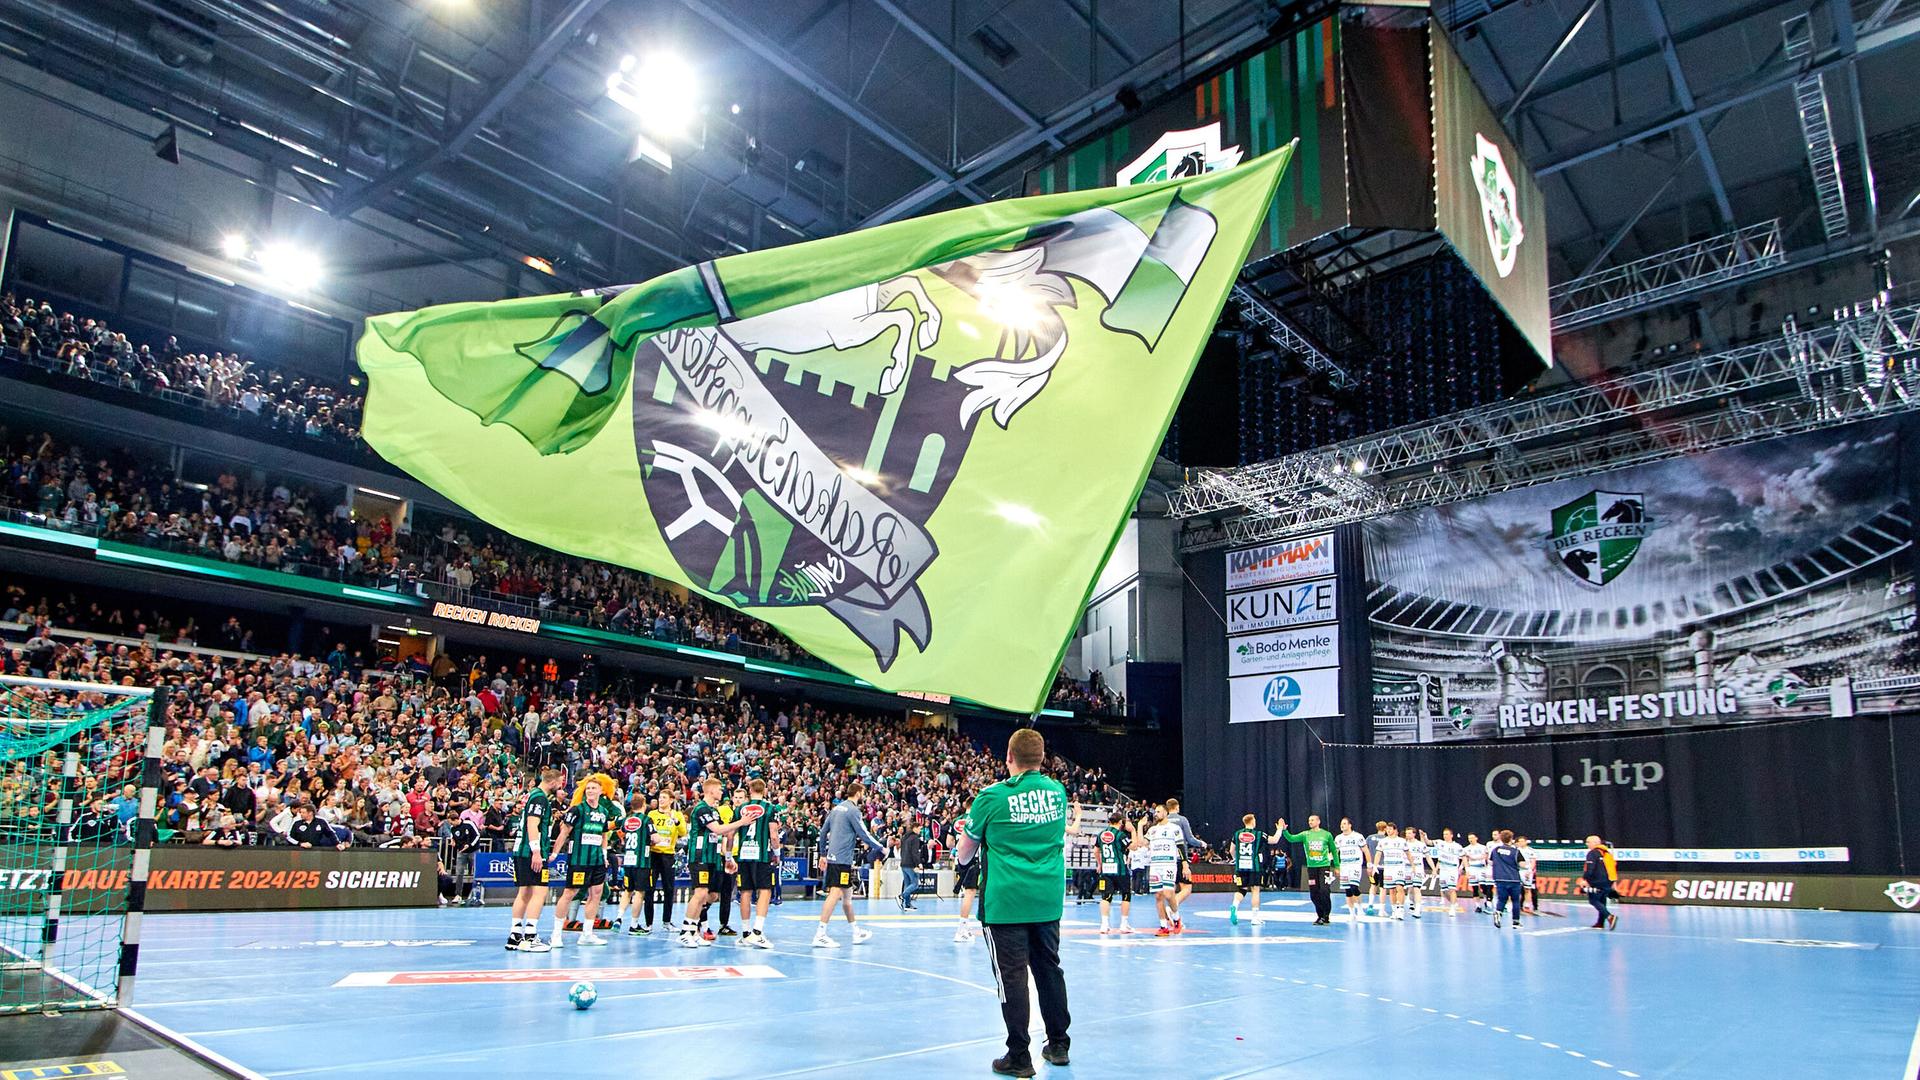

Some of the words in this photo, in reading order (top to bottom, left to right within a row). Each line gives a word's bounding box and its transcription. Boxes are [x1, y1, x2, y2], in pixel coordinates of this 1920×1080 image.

[1554, 534, 1580, 550] DIE
[1583, 525, 1647, 541] RECKEN
[1230, 537, 1329, 573] KAMPMANN
[1230, 584, 1332, 622] KUNZE
[433, 602, 488, 624] RECKEN
[488, 612, 541, 633] ROCKEN
[1230, 624, 1244, 632] IHR
[1247, 612, 1332, 629] IMMOBILIENMAKLER
[1256, 640, 1287, 654] Bodo
[1288, 635, 1330, 650] Menke
[1265, 679, 1298, 707] A2
[1270, 702, 1295, 711] CENTER
[1498, 687, 1737, 729] RECKEN-FESTUNG
[1580, 758, 1664, 791] htp
[656, 818, 666, 826] 27
[746, 819, 757, 840] 4
[625, 832, 638, 850] 28
[1239, 843, 1253, 856] 54
[1102, 844, 1115, 858] 61
[1617, 851, 1640, 859] DKB
[1673, 851, 1699, 859] DKB
[1734, 851, 1760, 860] DKB
[1798, 850, 1825, 859] DKB
[228, 870, 321, 889] 2024/25
[325, 870, 420, 889] SICHERN!
[1672, 880, 1794, 902] SICHERN!
